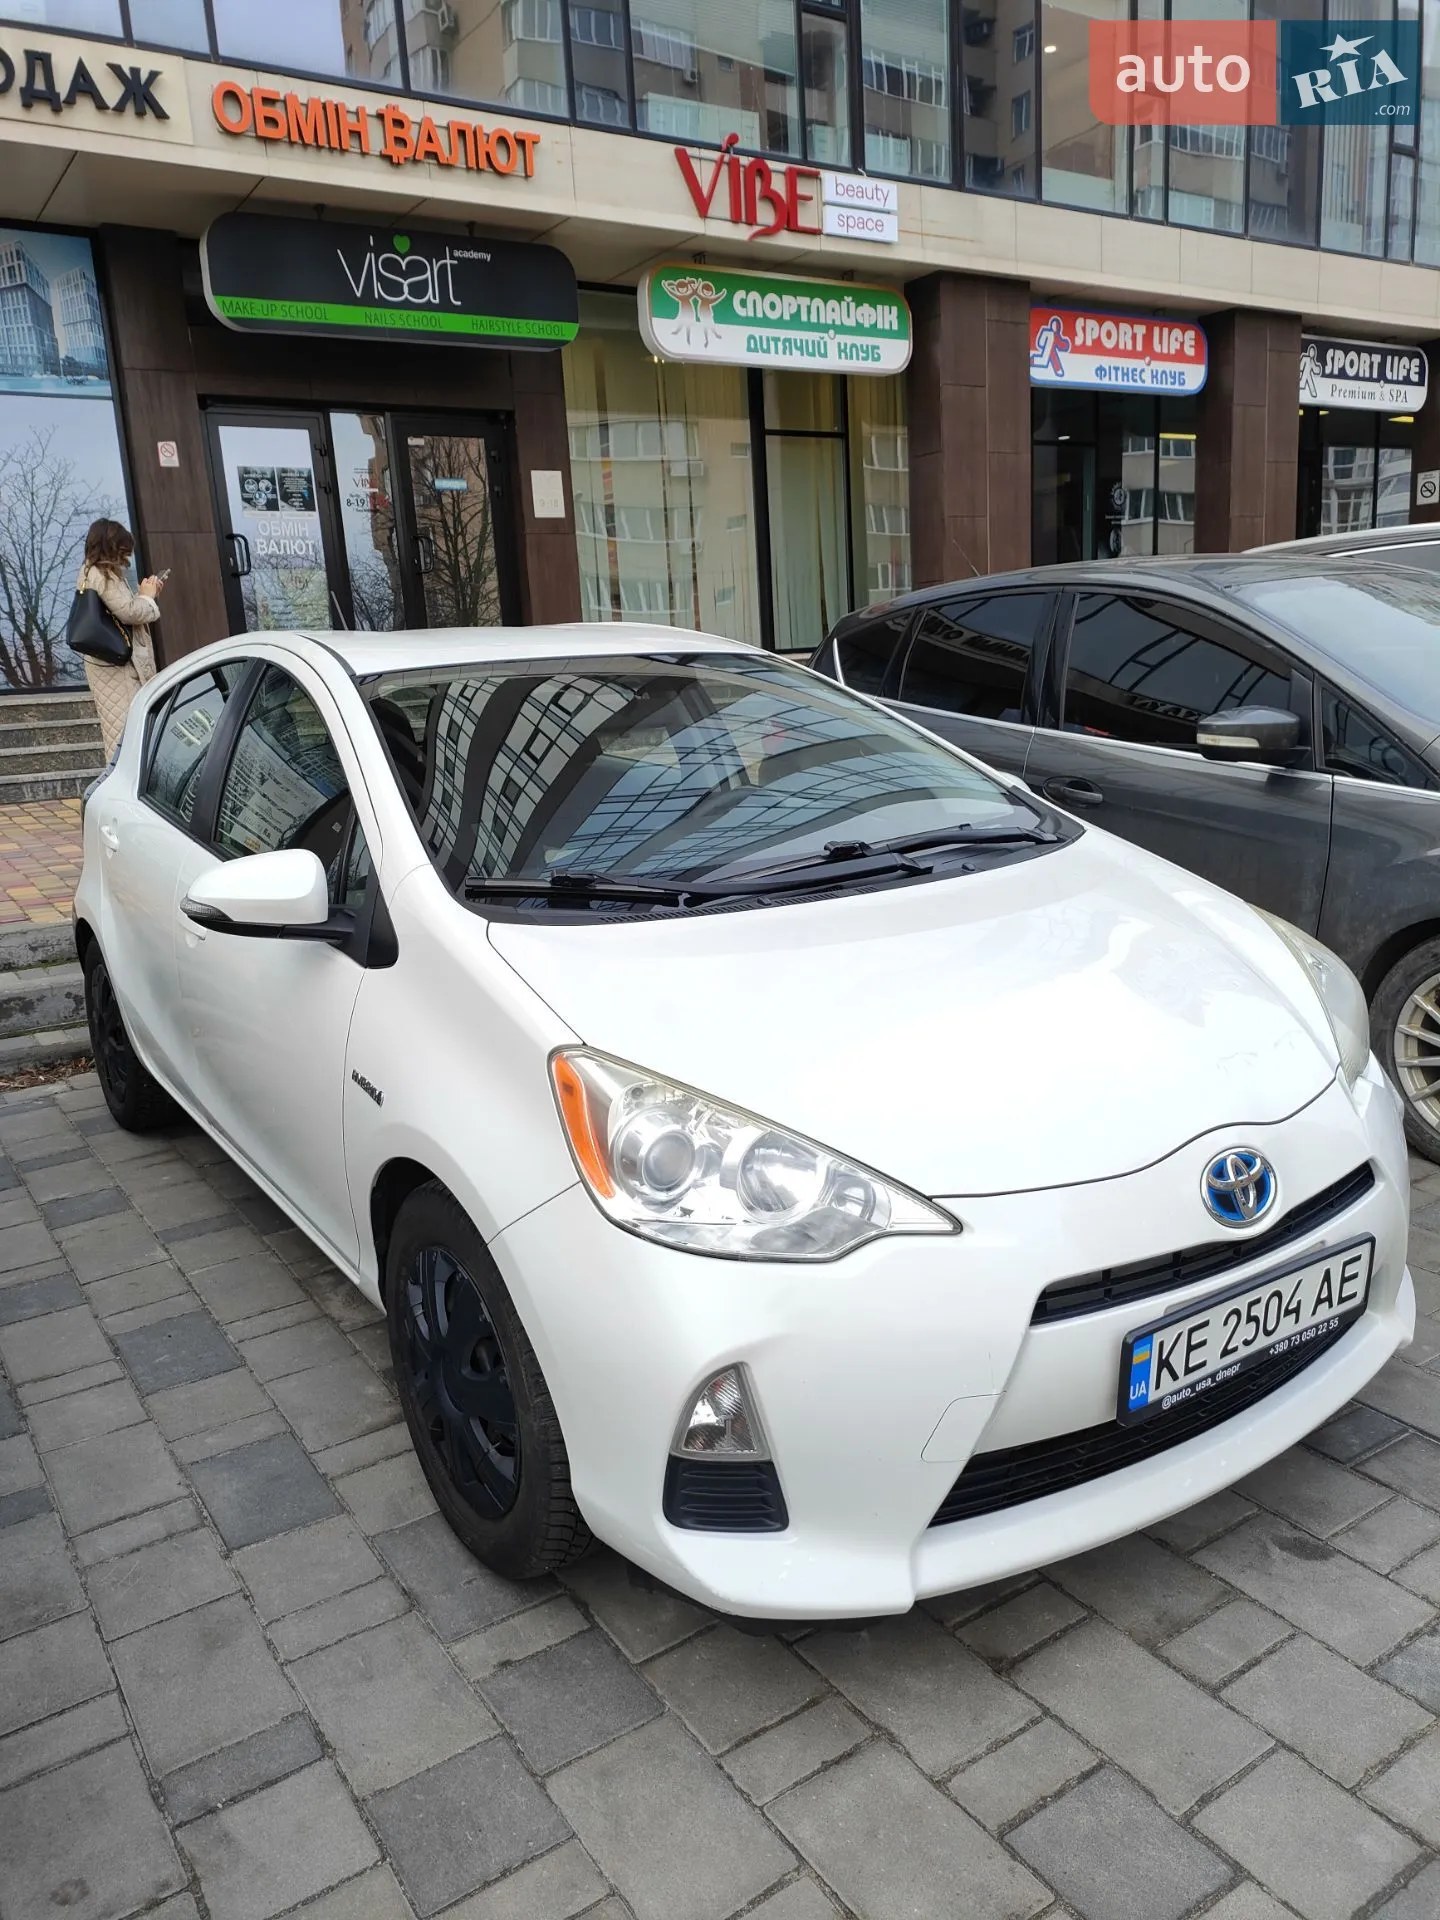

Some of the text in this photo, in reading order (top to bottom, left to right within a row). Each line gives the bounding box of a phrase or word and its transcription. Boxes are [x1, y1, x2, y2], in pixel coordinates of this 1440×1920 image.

[211, 80, 370, 154] ОБМІН
[834, 176, 890, 207] beauty
[837, 213, 884, 233] space
[453, 249, 492, 262] academy
[221, 300, 329, 321] MAKE-UP SCHOOL
[364, 311, 443, 329] NAILS SCHOOL
[471, 319, 566, 337] HAIRSTYLE SCHOOL
[1074, 317, 1196, 357] SPORT LIFE
[746, 334, 881, 362] ДИТЯЧИЙ КЛУБ
[1094, 364, 1186, 386] ФІТНЕС КЛУБ
[1325, 348, 1420, 382] SPORT LIFE
[1330, 384, 1376, 401] Premium
[1389, 388, 1408, 403] SPA
[258, 520, 309, 537] ОБМІН
[256, 538, 315, 555] ВАЛЮТ
[1154, 1253, 1363, 1390] KE 2504 AE
[1269, 1317, 1339, 1355] +380 73 050 22 55
[1130, 1380, 1147, 1399] UA
[1162, 1362, 1241, 1410] @auto_usa_dnepr
